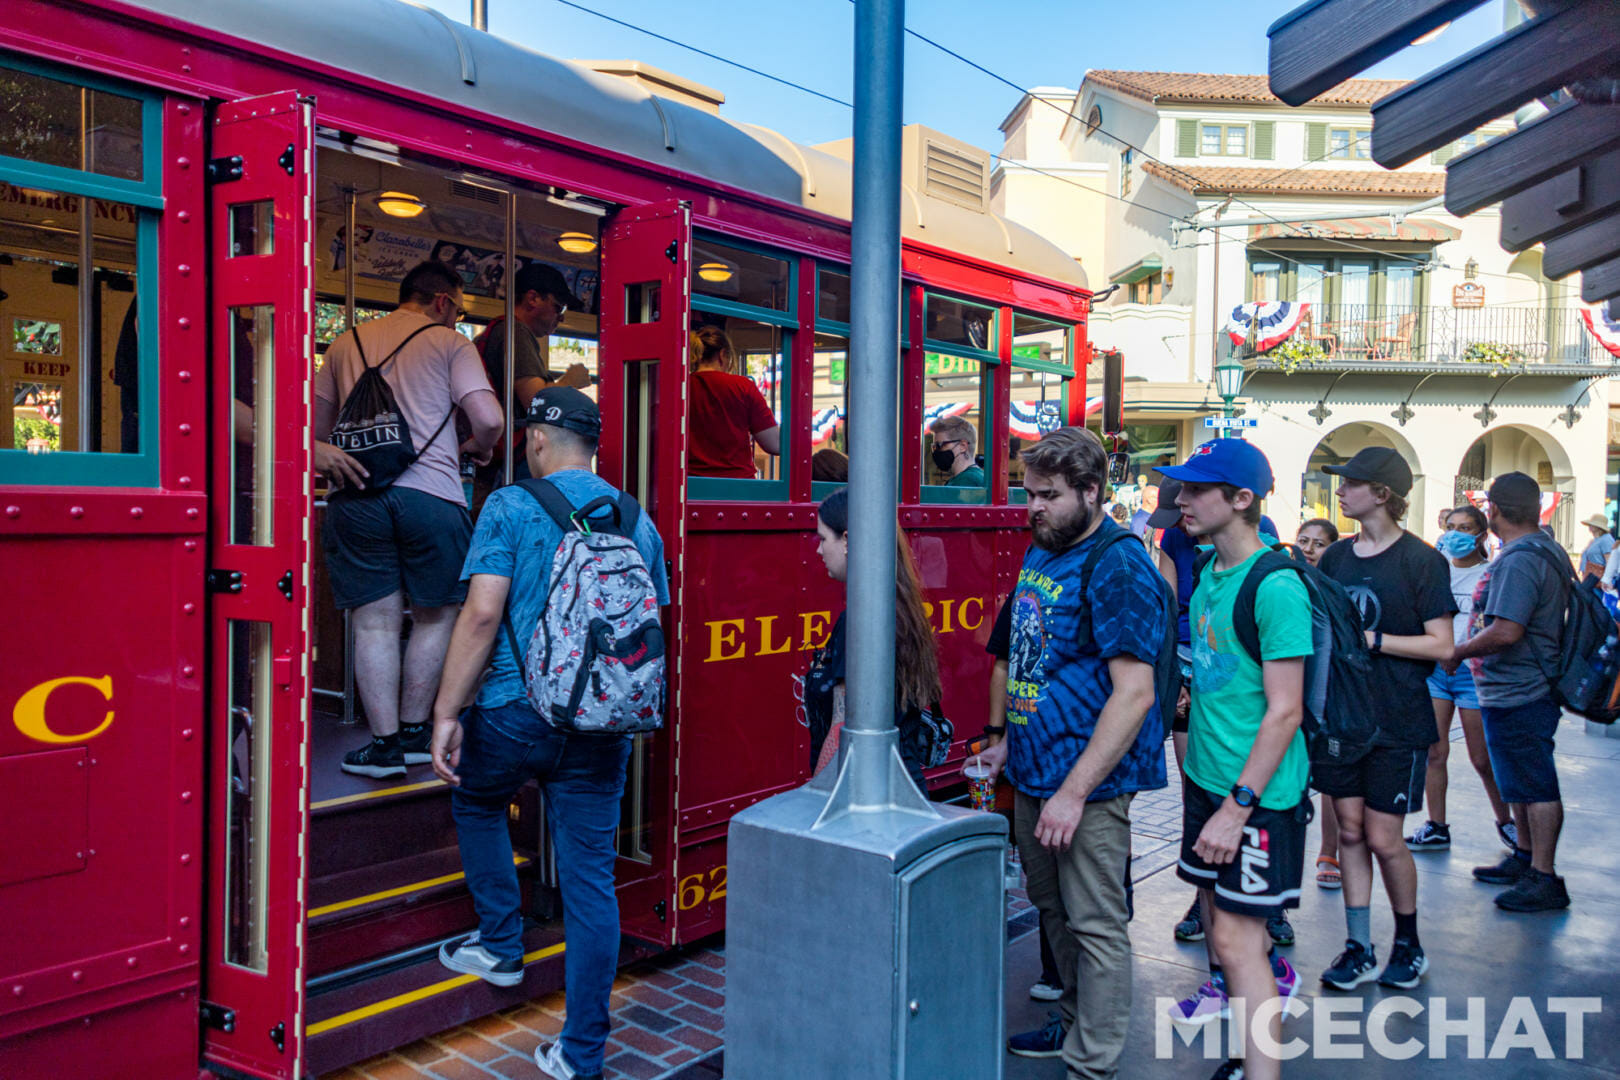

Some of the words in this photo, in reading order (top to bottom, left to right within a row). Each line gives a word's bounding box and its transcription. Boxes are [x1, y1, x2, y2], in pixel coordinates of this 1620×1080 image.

[24, 361, 71, 377] KEEP
[13, 674, 115, 744] C
[1241, 825, 1270, 894] FILA
